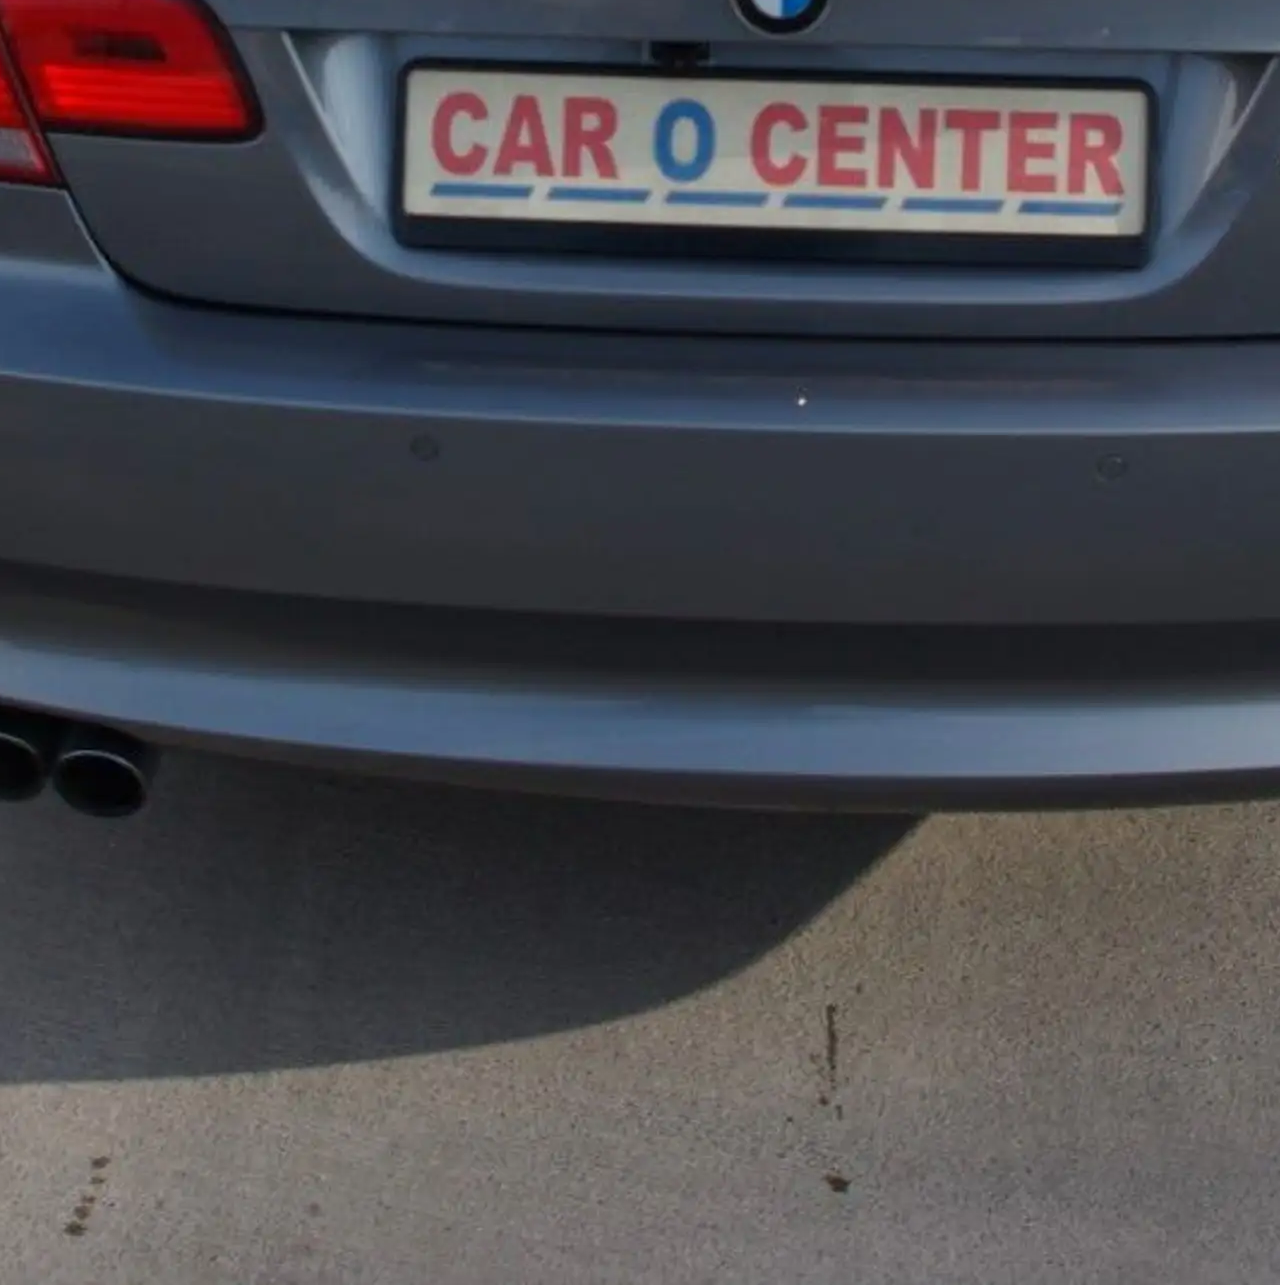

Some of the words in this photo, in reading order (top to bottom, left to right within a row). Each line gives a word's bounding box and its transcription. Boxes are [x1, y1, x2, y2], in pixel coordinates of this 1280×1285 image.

[431, 91, 621, 180] CAR
[654, 97, 716, 184] O
[749, 101, 1125, 195] CENTER
